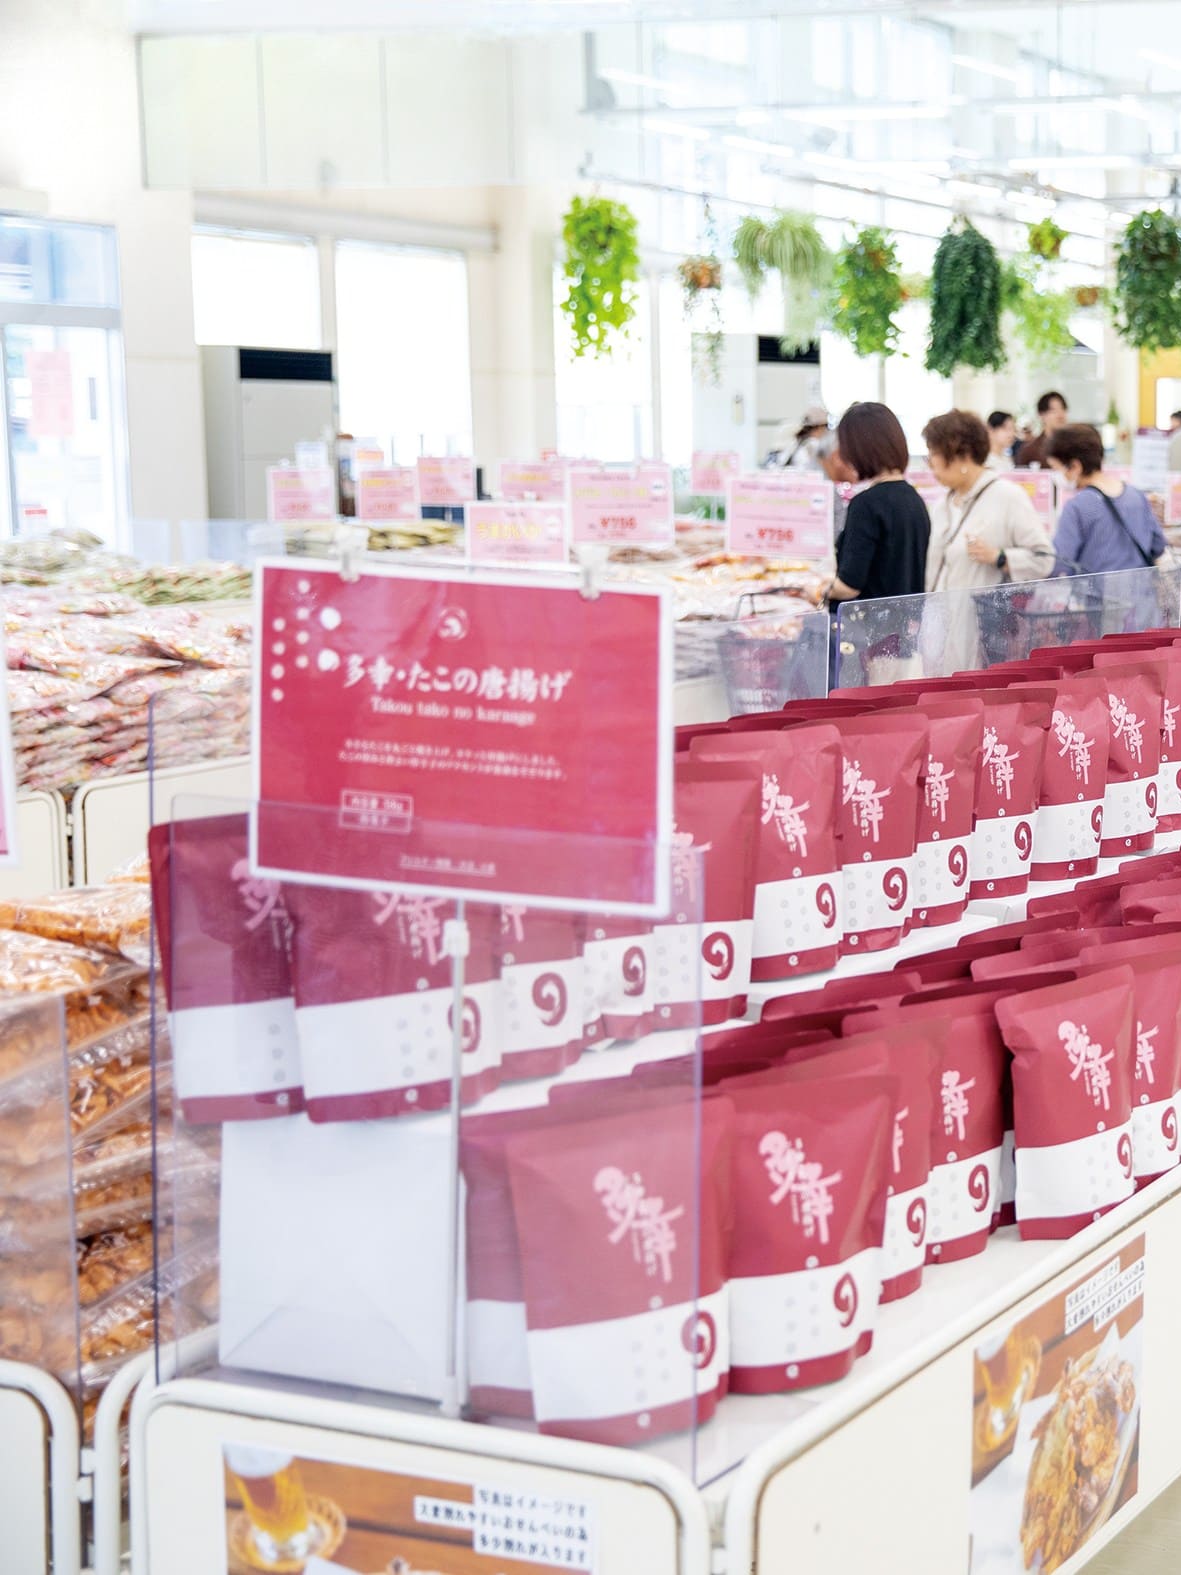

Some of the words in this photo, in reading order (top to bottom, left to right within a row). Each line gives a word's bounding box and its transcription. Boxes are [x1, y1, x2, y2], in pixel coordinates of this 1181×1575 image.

[344, 653, 573, 703] 多幸・たこの唐揚げ
